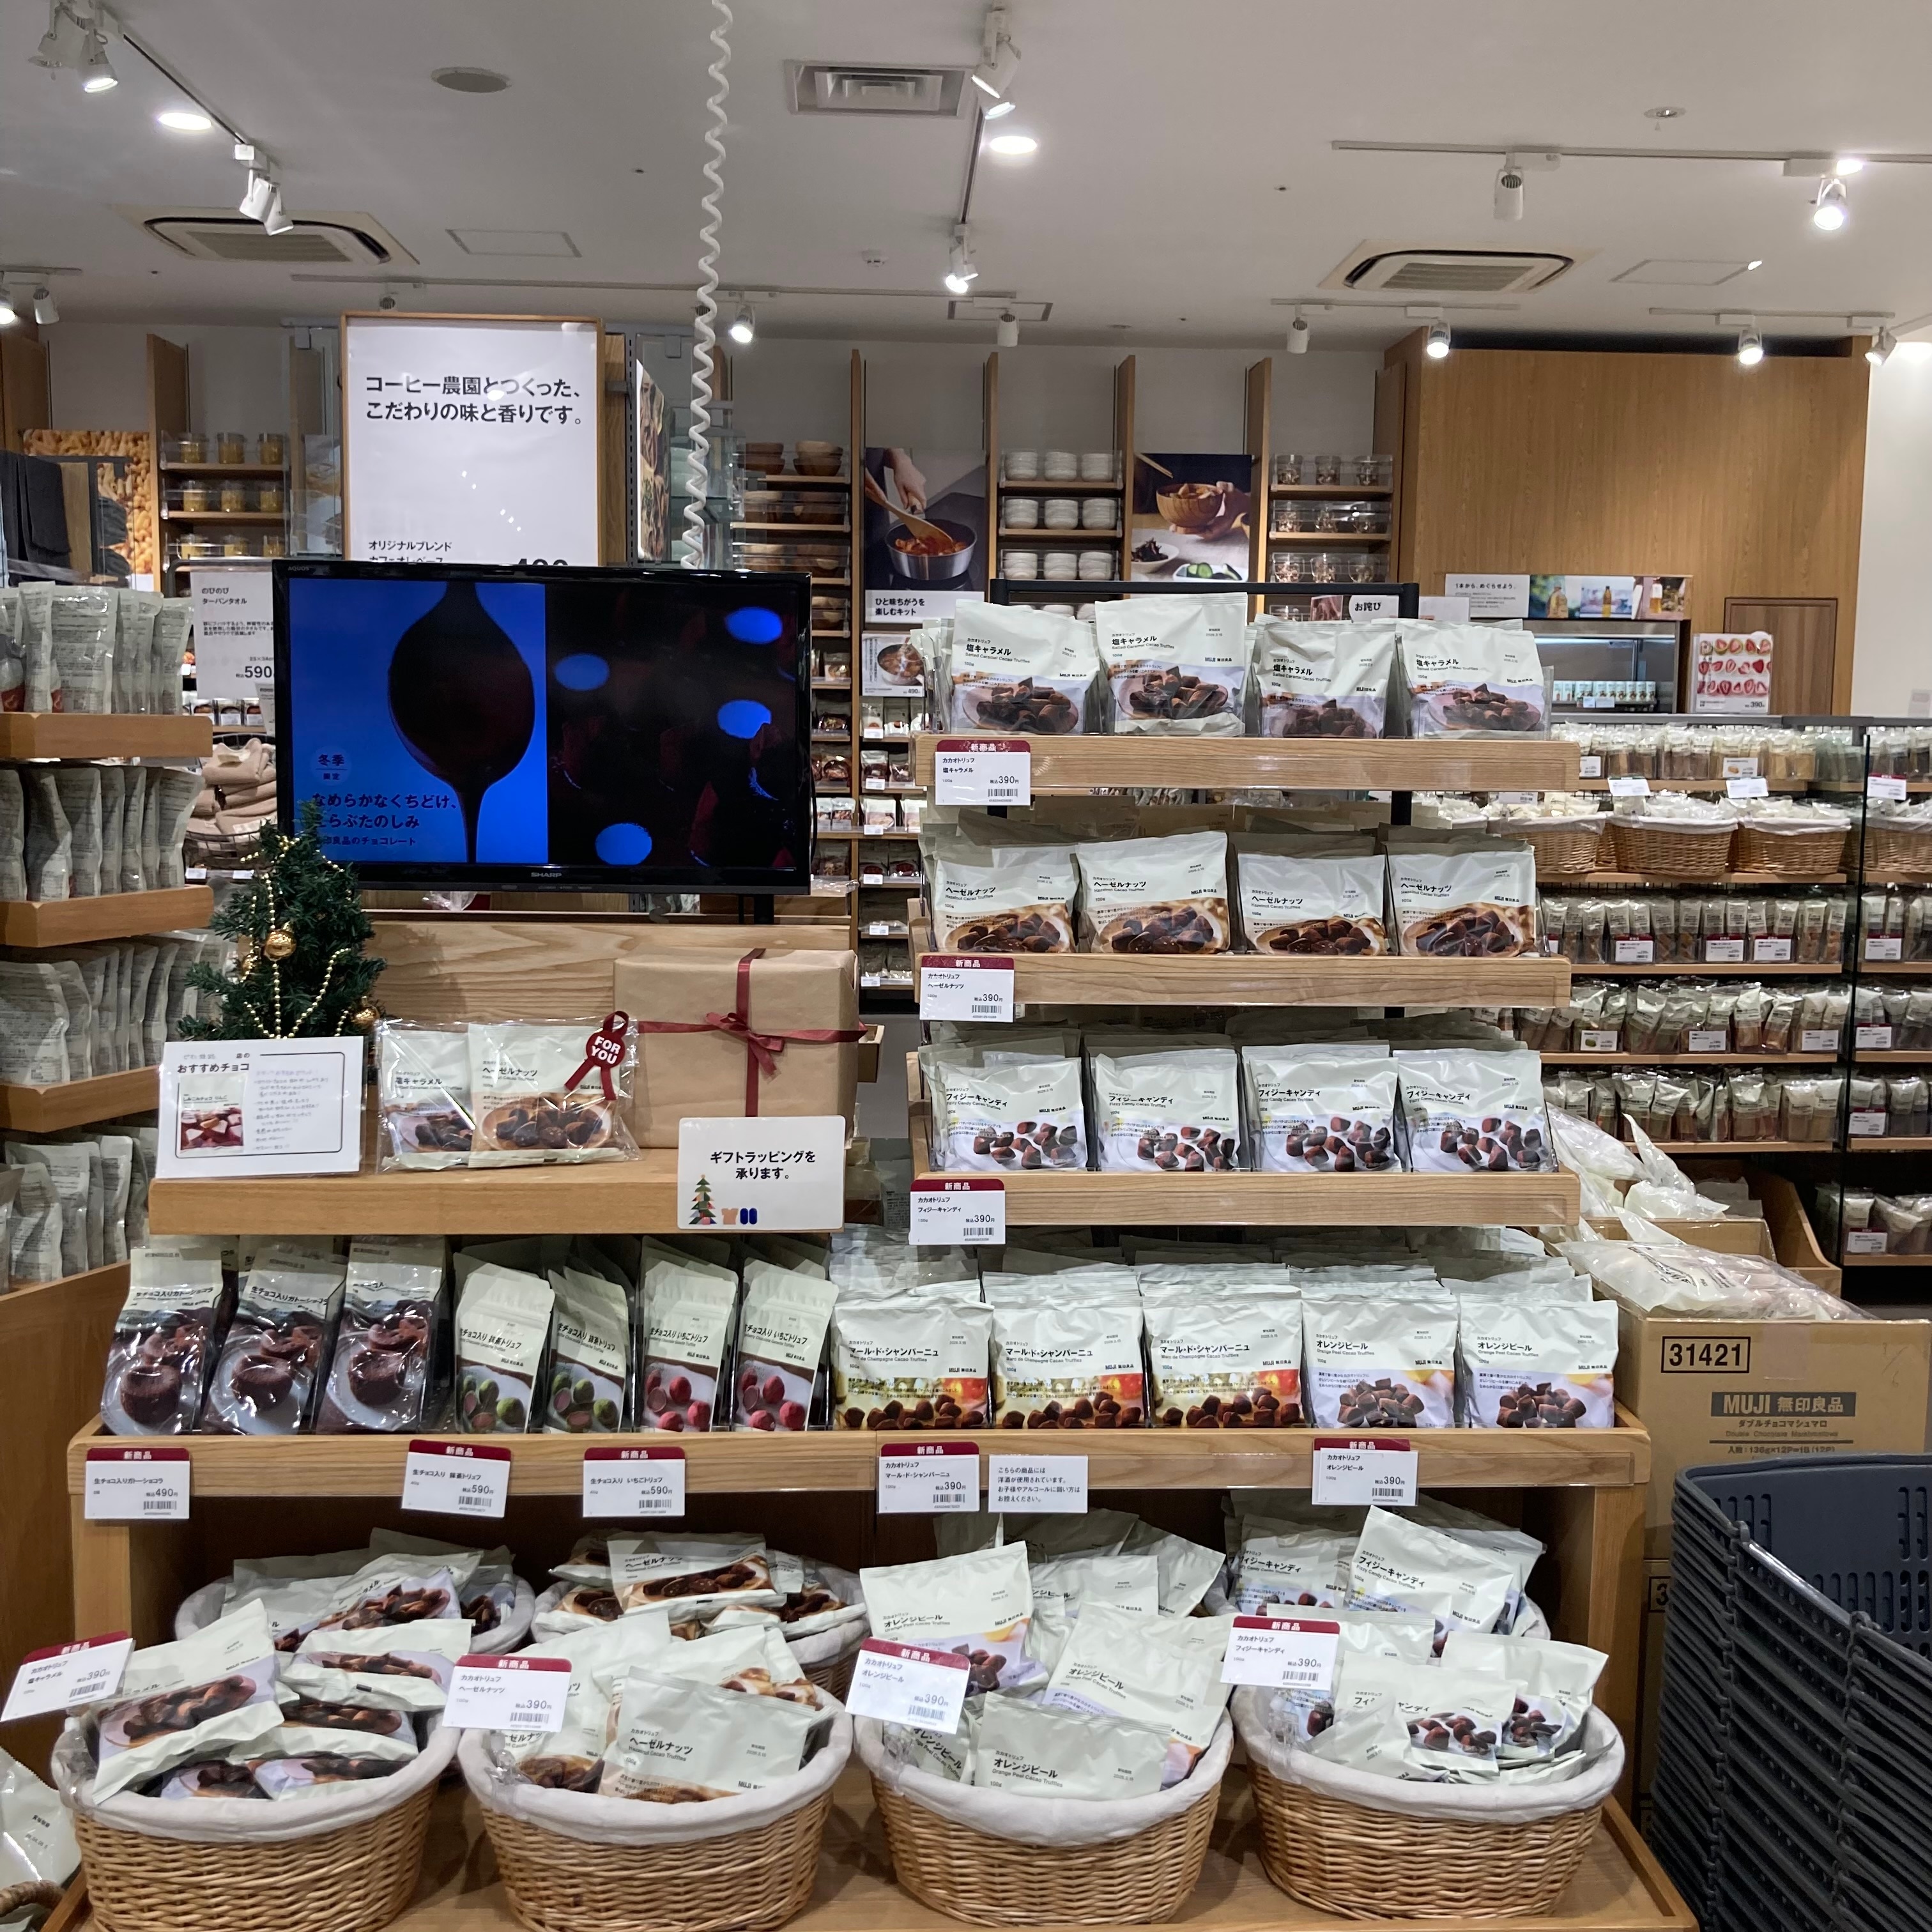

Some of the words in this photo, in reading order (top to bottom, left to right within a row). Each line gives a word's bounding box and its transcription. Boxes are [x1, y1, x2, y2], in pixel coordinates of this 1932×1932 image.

[366, 374, 579, 397] コーヒー農園とつくった、
[366, 401, 582, 425] こだわりの味と香りです。
[369, 539, 452, 551] オリジナルブレンド
[875, 598, 925, 606] ひと味ちがうを
[1354, 602, 1381, 611] お詫び
[1112, 635, 1158, 646] 塩キャラメル
[966, 643, 1011, 657] 塩キャラメル
[1416, 658, 1459, 667] 塩キャラメル
[1273, 663, 1314, 676] 塩キャラメル
[318, 754, 345, 766] 冬季
[312, 793, 456, 809] なめらかなくちどけ、
[323, 836, 415, 846] 印良品のチョコレート
[1094, 880, 1147, 889] ヘーゼルナッツ
[1400, 882, 1452, 893] ヘーゼルナッツ
[946, 886, 996, 896] ヘーゼルナッツ
[1252, 896, 1303, 905] ヘーゼルナッツ
[594, 1036, 621, 1054] FOR
[590, 1045, 618, 1064] YOU
[178, 1063, 250, 1073] おすすめチョコ
[395, 1077, 443, 1085] 塩キャラメル
[1259, 1089, 1321, 1098] フィジーキャンディ
[1407, 1090, 1471, 1101] フィジーキャンディ
[946, 1092, 1008, 1107] フィジーキャンディ
[1108, 1094, 1174, 1105] フィジーキャンディ
[710, 1151, 816, 1163] ギフトラッピングを
[735, 1167, 790, 1179] 承ります。
[558, 1322, 587, 1340] 生チョコ入り
[650, 1327, 676, 1338] 生チョコ入り
[677, 1332, 709, 1343] いちごトリュフ
[774, 1331, 808, 1344] いちごトリュフ
[1317, 1340, 1368, 1350] オレンジピール
[1478, 1342, 1532, 1351] オレンジピール
[1669, 1343, 1741, 1367] 31421
[1723, 1395, 1771, 1414] MUJI
[1777, 1397, 1843, 1413] 無印良品
[917, 1445, 944, 1454] 新商品
[1349, 1441, 1376, 1450] 新商品
[124, 1451, 152, 1459] 新商品
[446, 1446, 473, 1457] 新商品
[621, 1450, 648, 1459] 新商品
[413, 1469, 445, 1478] 生チョコ入り
[625, 1556, 682, 1567] ヘーゼルナッツ
[1359, 1556, 1425, 1587] フィジーキャンディ
[884, 1614, 943, 1628] オレンジピール
[1271, 1621, 1300, 1631] 新商品
[901, 1648, 930, 1662] 新商品
[1236, 1645, 1285, 1654] フィジーキャンディ
[498, 1660, 530, 1669] 新商品
[864, 1658, 903, 1670] カカオトリュフ
[862, 1669, 904, 1683] オレンジピール
[1068, 1667, 1124, 1690] オレンジピール
[631, 1728, 659, 1736] カカオトリュフ
[629, 1737, 693, 1755] ヘーゼルナッツ
[993, 1758, 1058, 1779] オレンジピール
[738, 1781, 751, 1789] MUJI
[1043, 1777, 1063, 1788] Truffles
